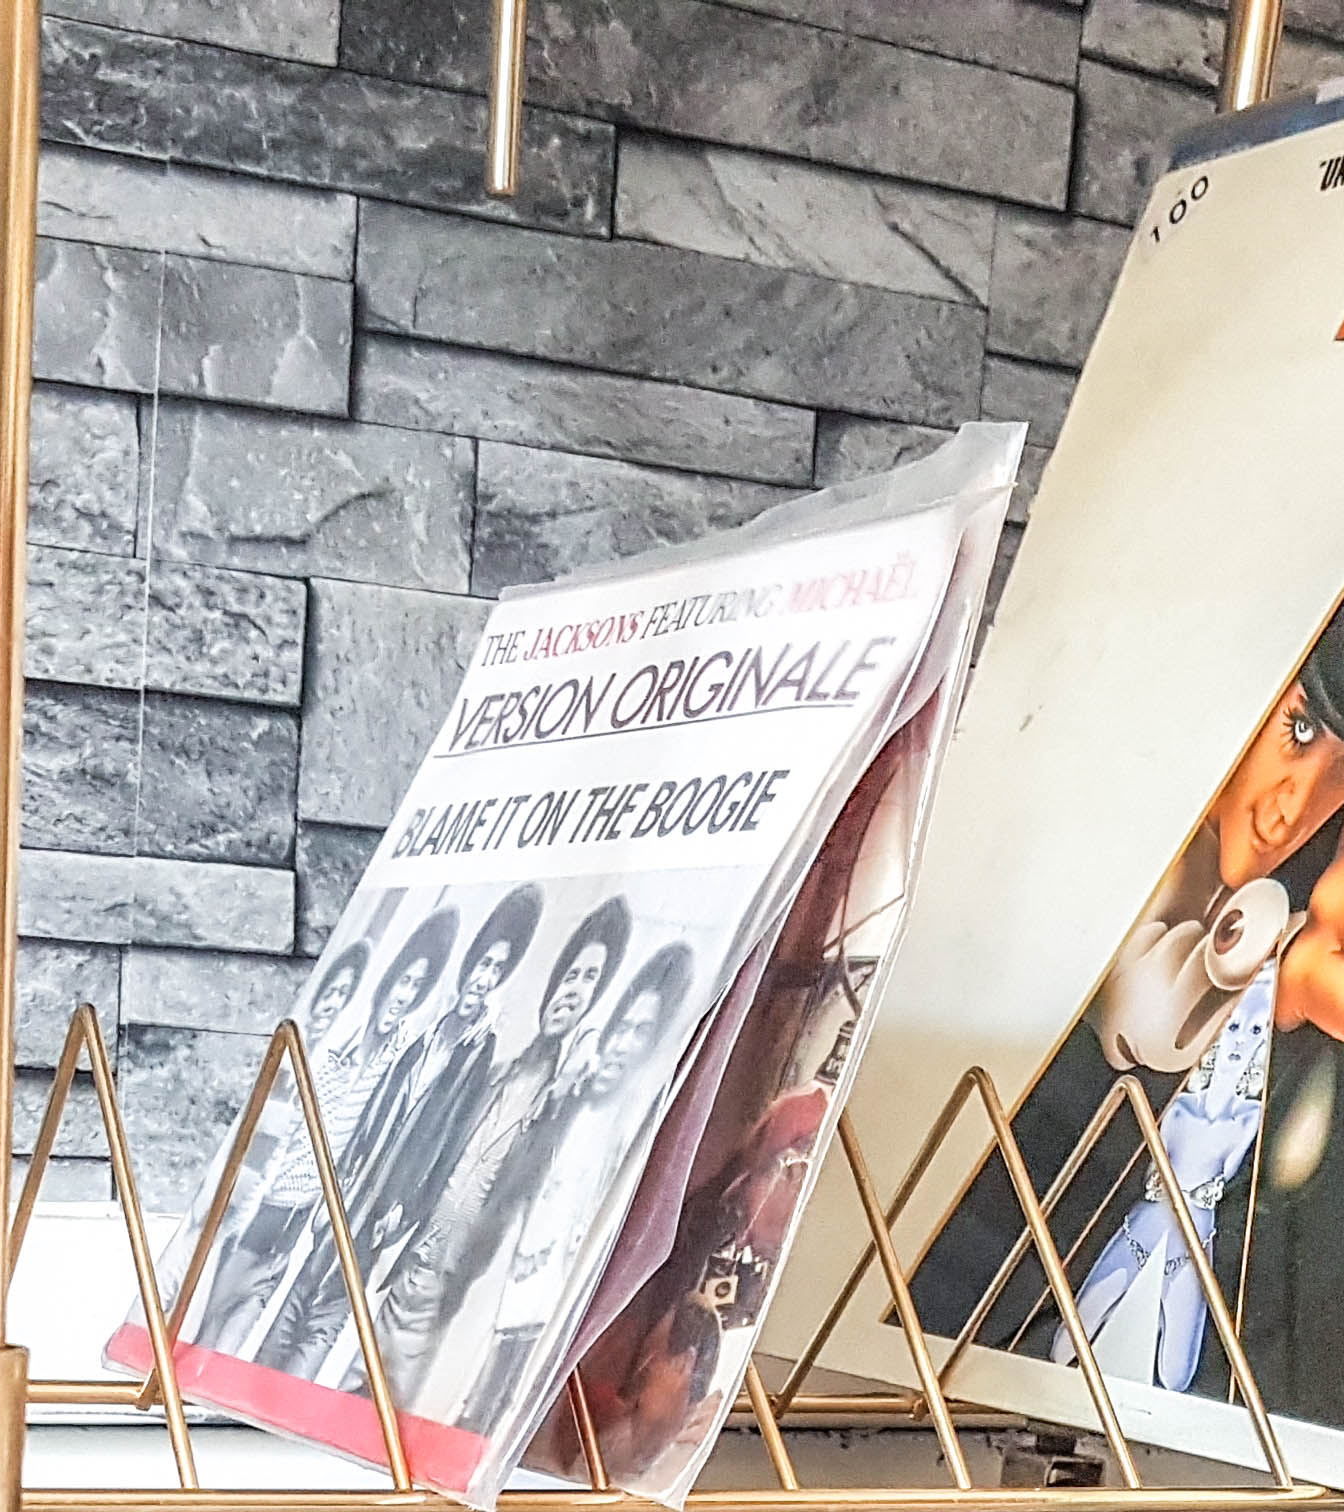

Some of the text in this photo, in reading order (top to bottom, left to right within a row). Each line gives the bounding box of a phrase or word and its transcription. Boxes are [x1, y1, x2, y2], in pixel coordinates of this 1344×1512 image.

[481, 620, 526, 667] THE
[523, 600, 645, 661] JACKSONS
[639, 583, 784, 640] FEATURING
[446, 636, 897, 753] VERSION ORIGINALE
[391, 769, 791, 860] BLAME IT ON THE BOOGIE
